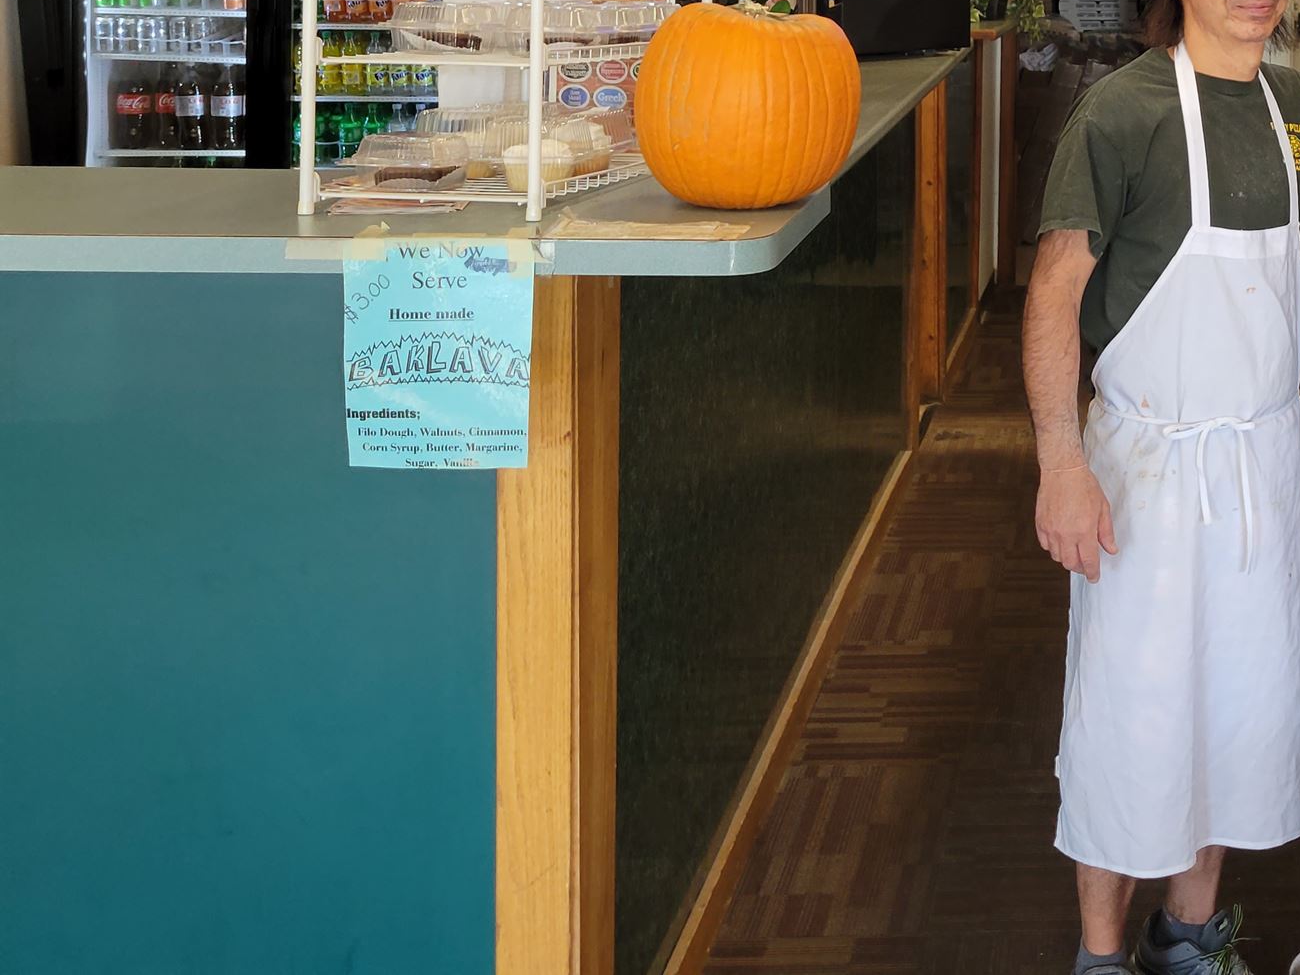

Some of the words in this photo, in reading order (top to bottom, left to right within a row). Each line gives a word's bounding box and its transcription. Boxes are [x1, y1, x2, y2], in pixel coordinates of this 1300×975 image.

[598, 93, 624, 103] Greek
[397, 241, 431, 259] We
[438, 241, 484, 259] Now
[412, 271, 468, 290] Serve
[388, 308, 432, 320] Home
[436, 308, 474, 320] made
[348, 341, 532, 382] BAKLAVA
[358, 427, 377, 437] Filo
[362, 443, 388, 452] Corn
